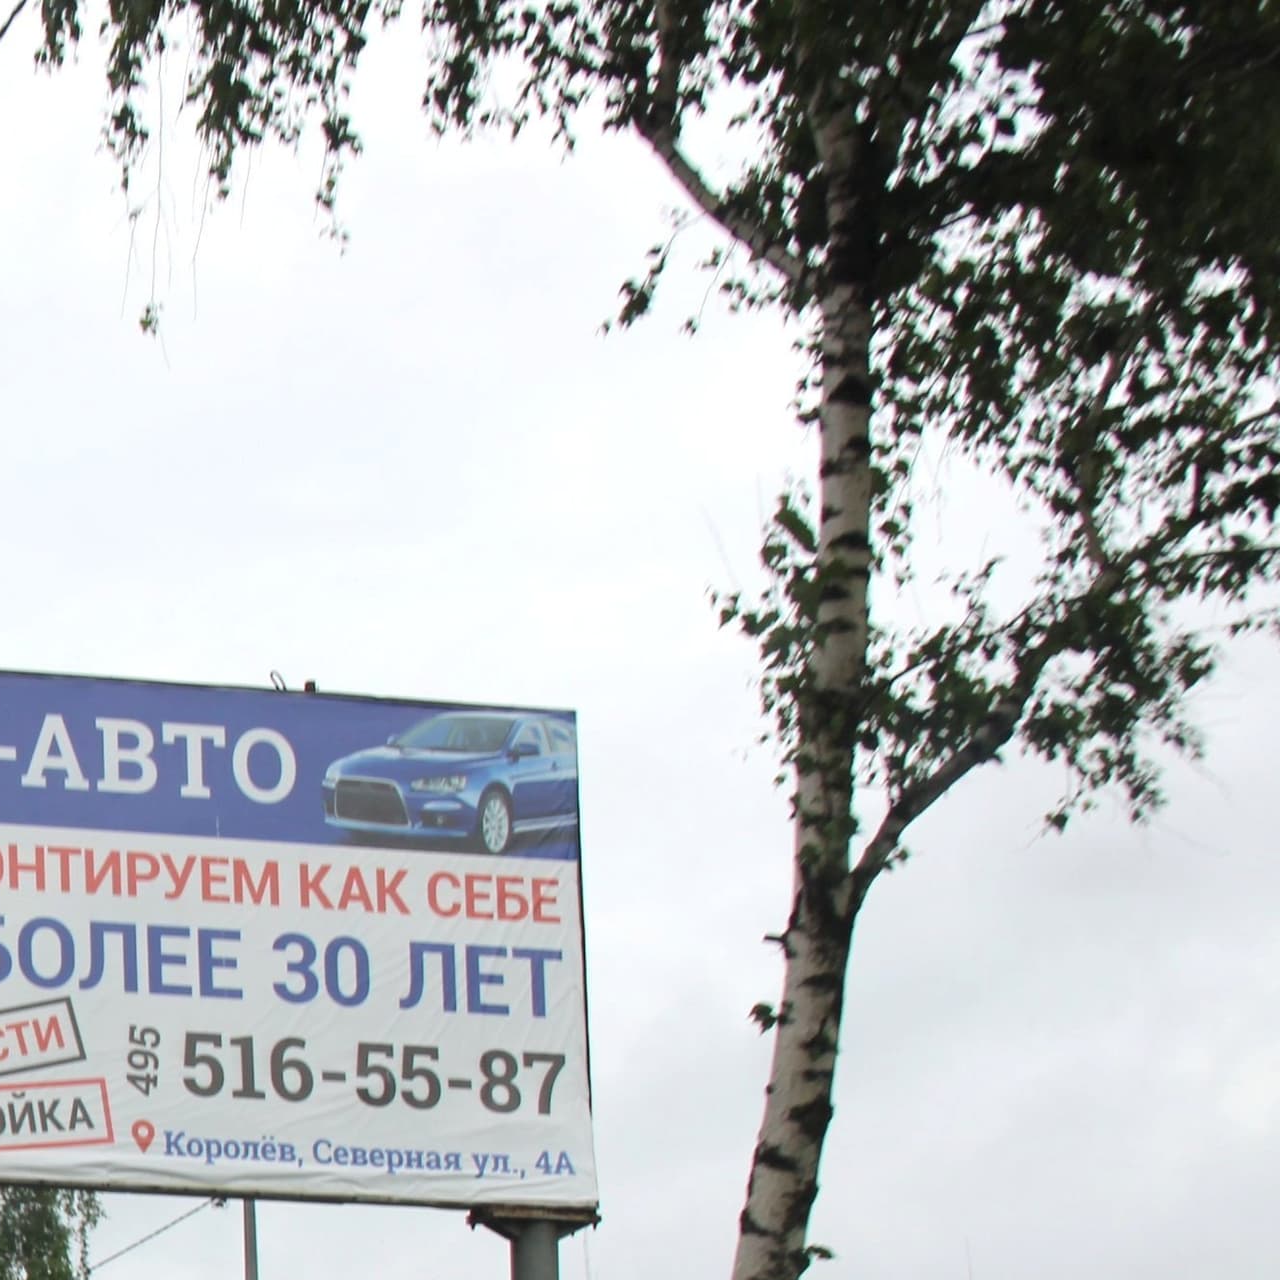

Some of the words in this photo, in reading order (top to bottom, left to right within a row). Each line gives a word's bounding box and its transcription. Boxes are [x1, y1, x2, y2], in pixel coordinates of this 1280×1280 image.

[298, 862, 412, 915] КАК
[426, 871, 562, 924] СЕБЕ
[271, 932, 371, 1007] 30
[399, 940, 563, 1018] ЛЕТ
[126, 1024, 161, 1097] 495
[182, 1030, 567, 1116] 516-55-87
[162, 1130, 305, 1167] Королёв,
[312, 1139, 461, 1174] Северная
[472, 1152, 526, 1179] ул.,
[534, 1150, 576, 1176] 4А
